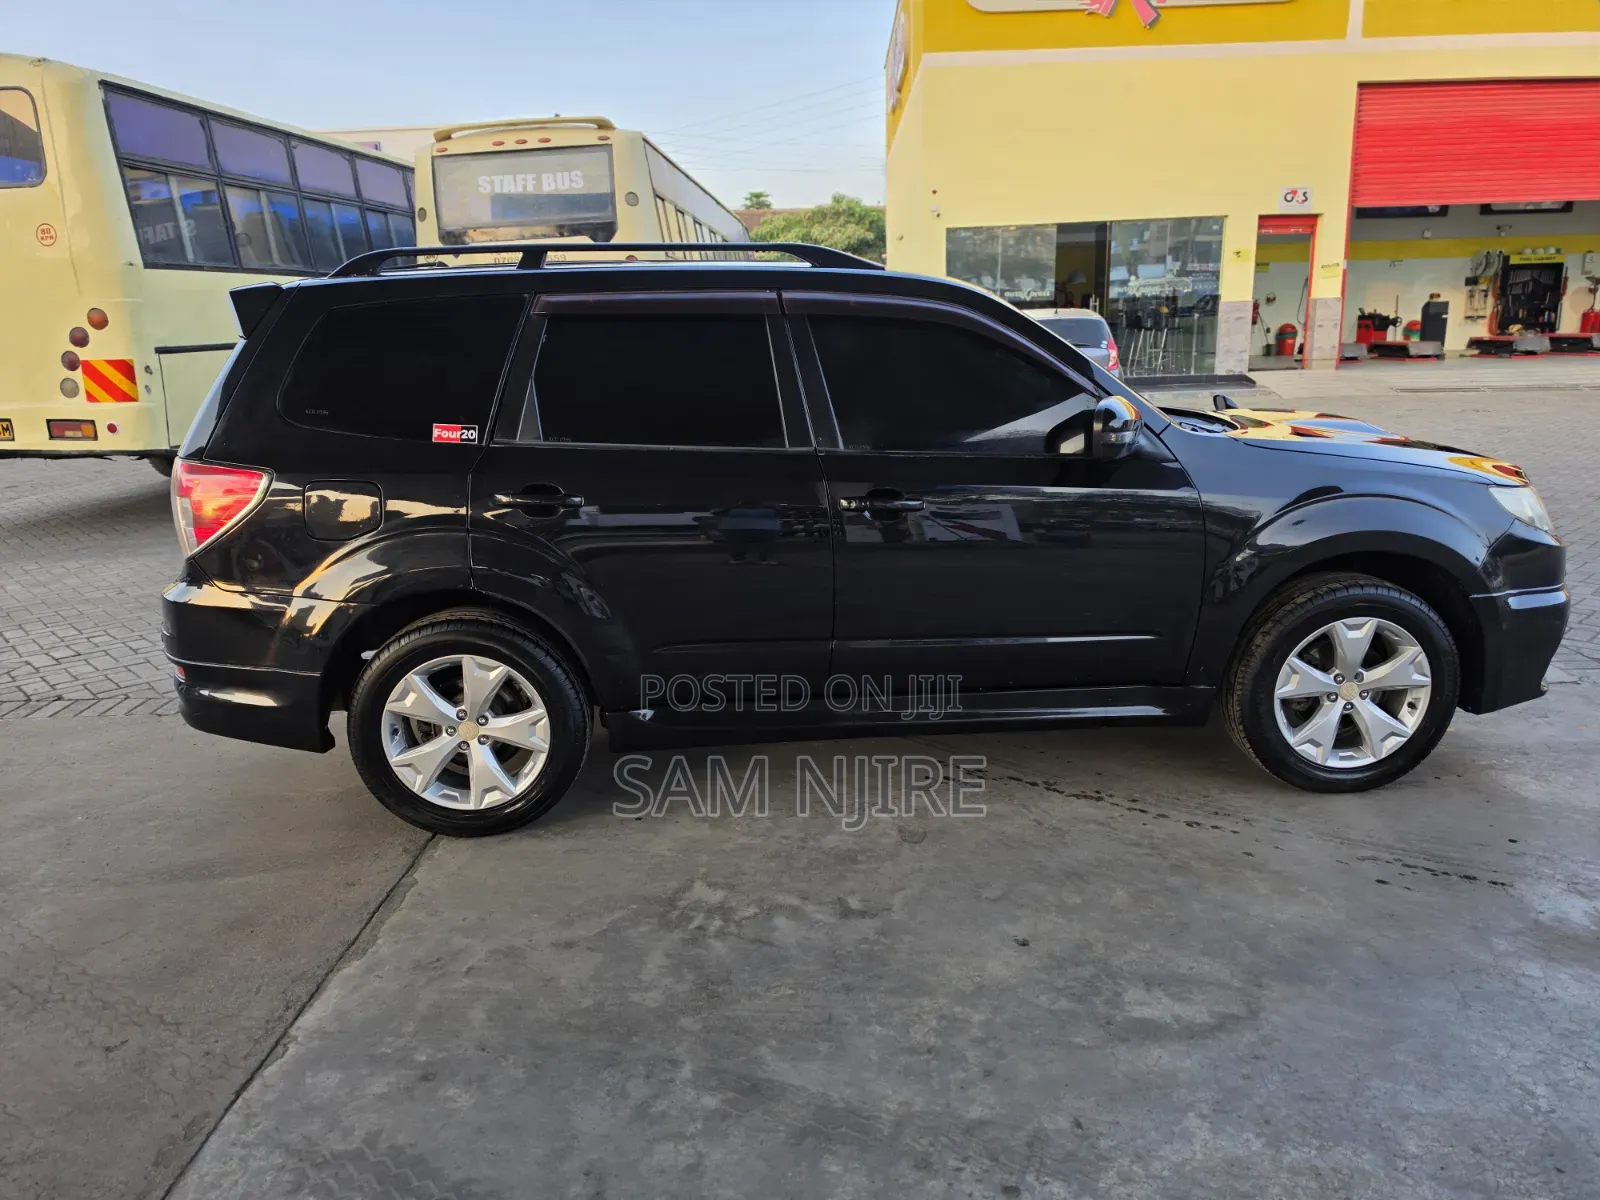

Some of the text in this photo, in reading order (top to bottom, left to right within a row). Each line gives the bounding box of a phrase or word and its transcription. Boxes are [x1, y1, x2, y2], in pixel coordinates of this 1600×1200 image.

[478, 170, 584, 193] STAFF BUS
[434, 428, 476, 439] Four20
